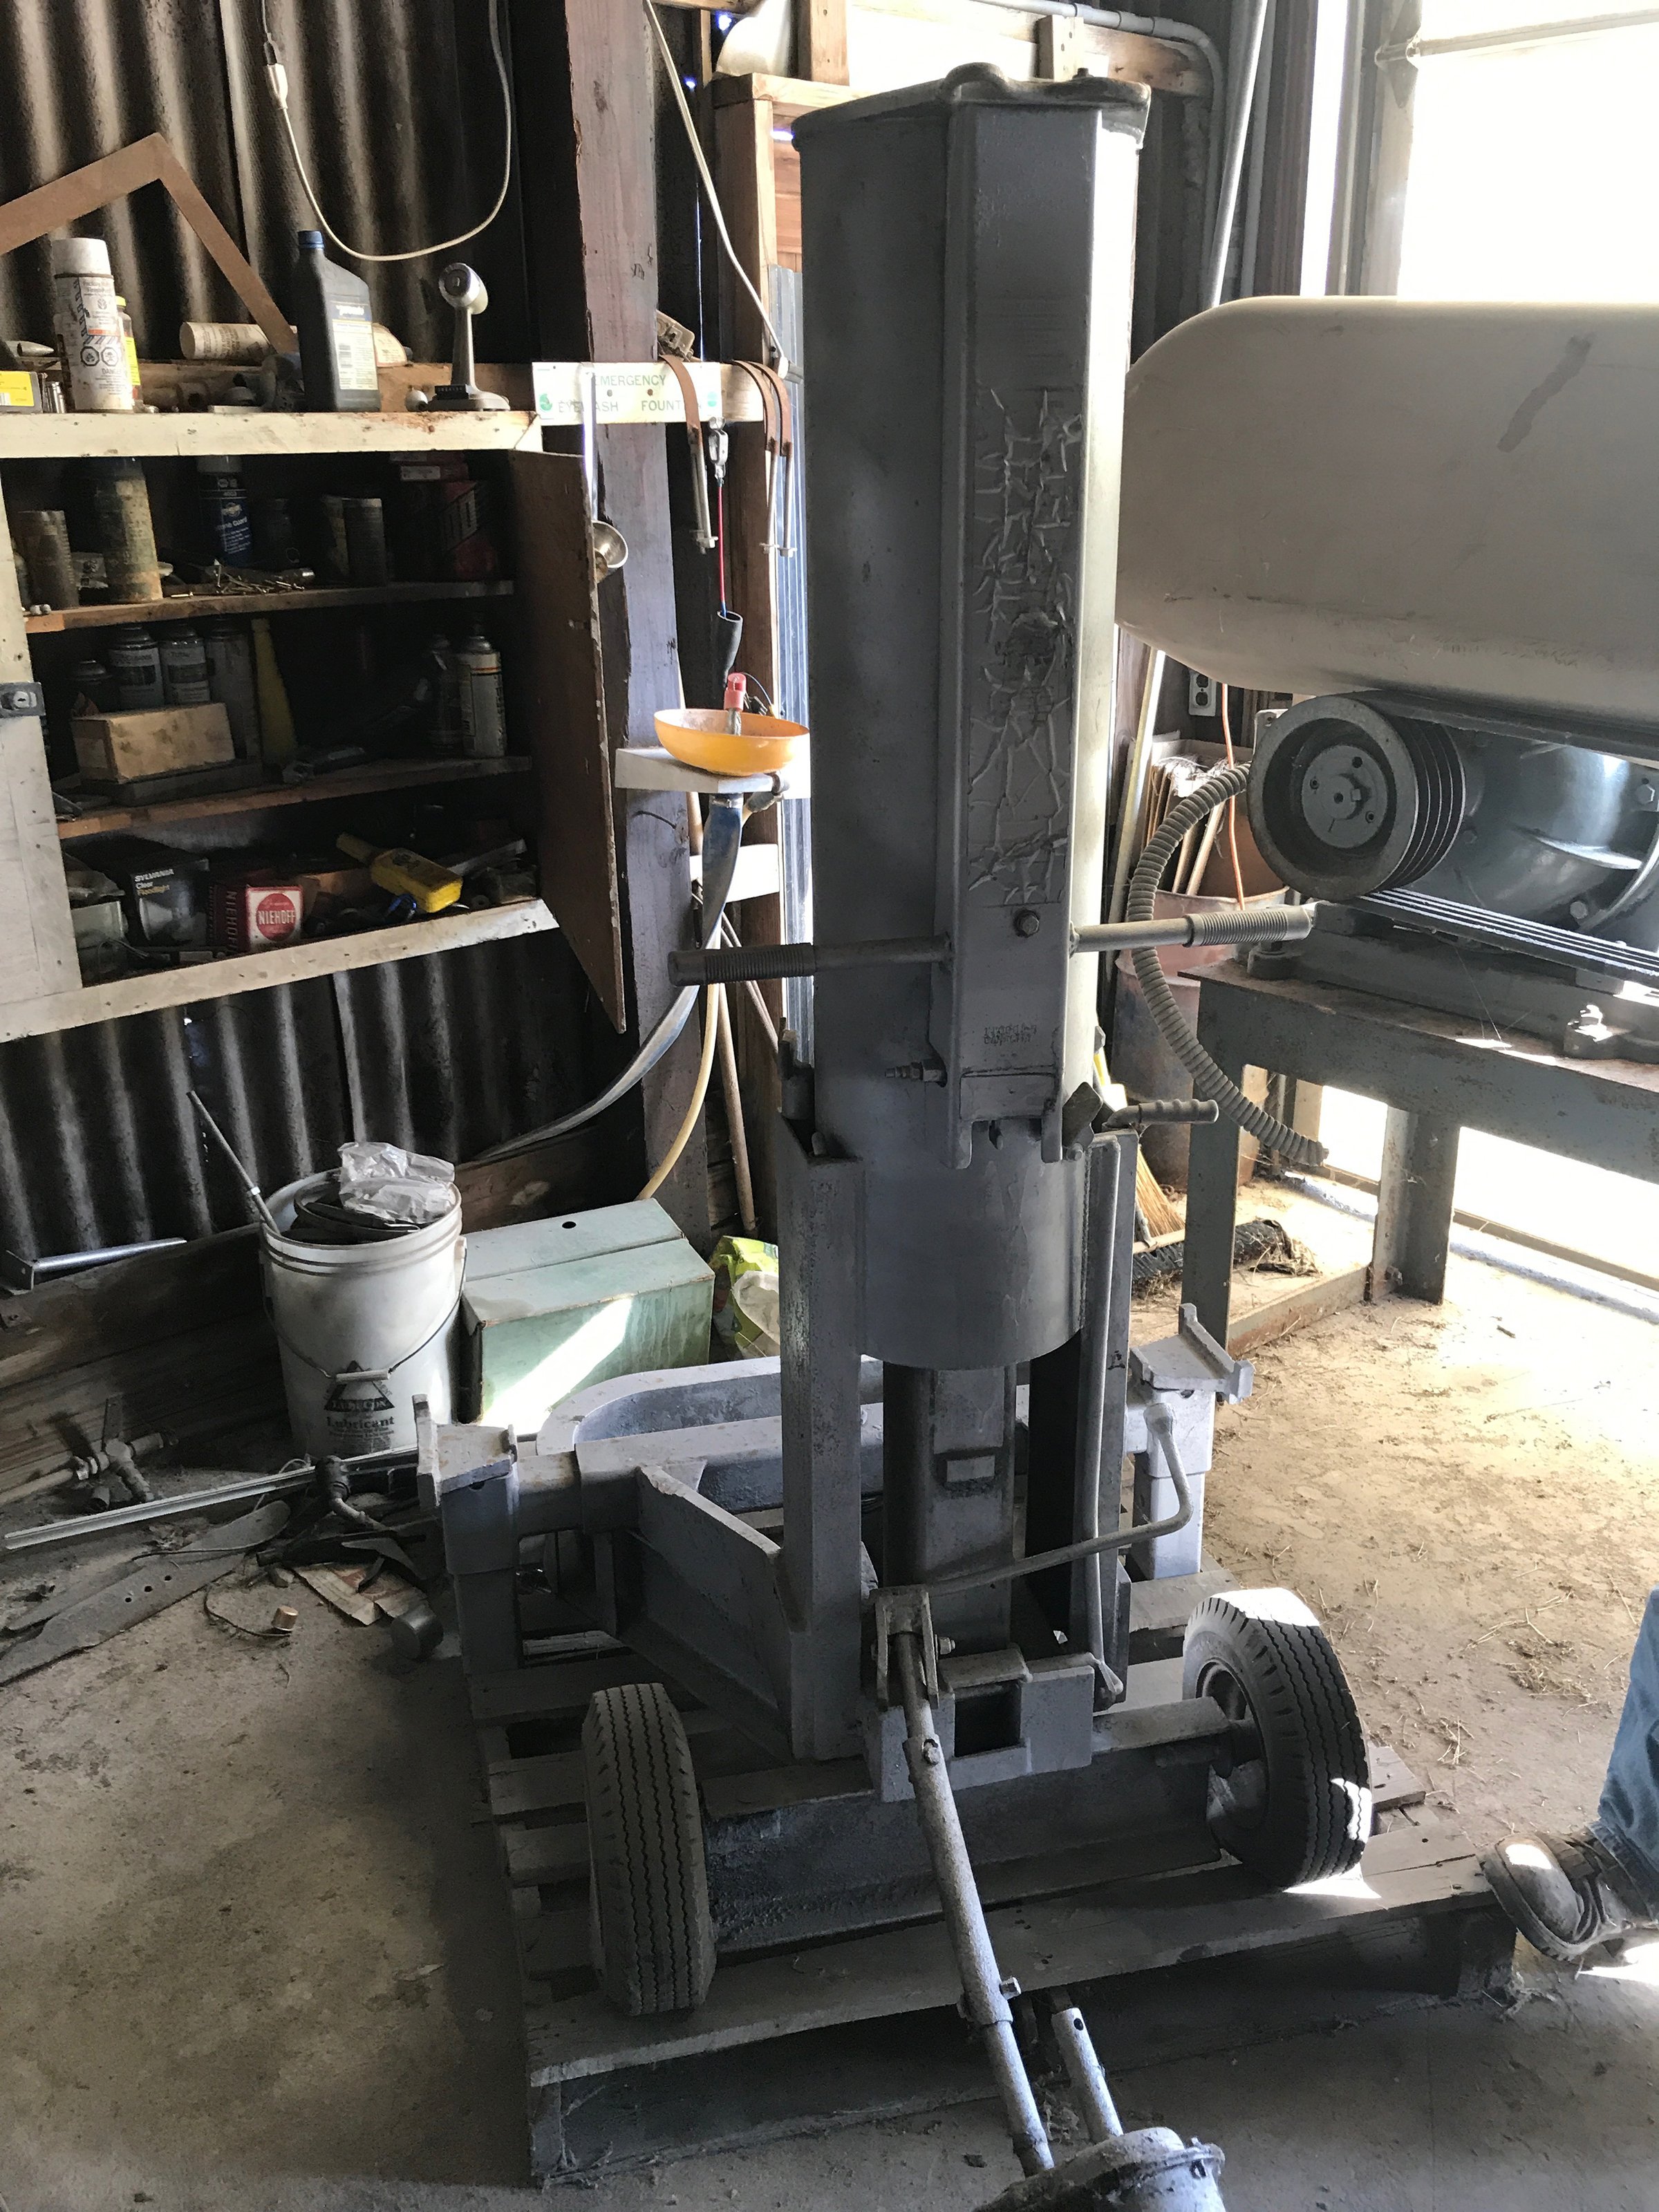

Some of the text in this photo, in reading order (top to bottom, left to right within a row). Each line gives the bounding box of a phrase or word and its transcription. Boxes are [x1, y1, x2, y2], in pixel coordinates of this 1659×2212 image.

[595, 375, 666, 386] EMERGENCY
[559, 401, 619, 413] EYEASH
[134, 868, 175, 882] SYLVANIA
[258, 910, 297, 925] NIEHOFF
[326, 1416, 395, 1429] Lubricant
